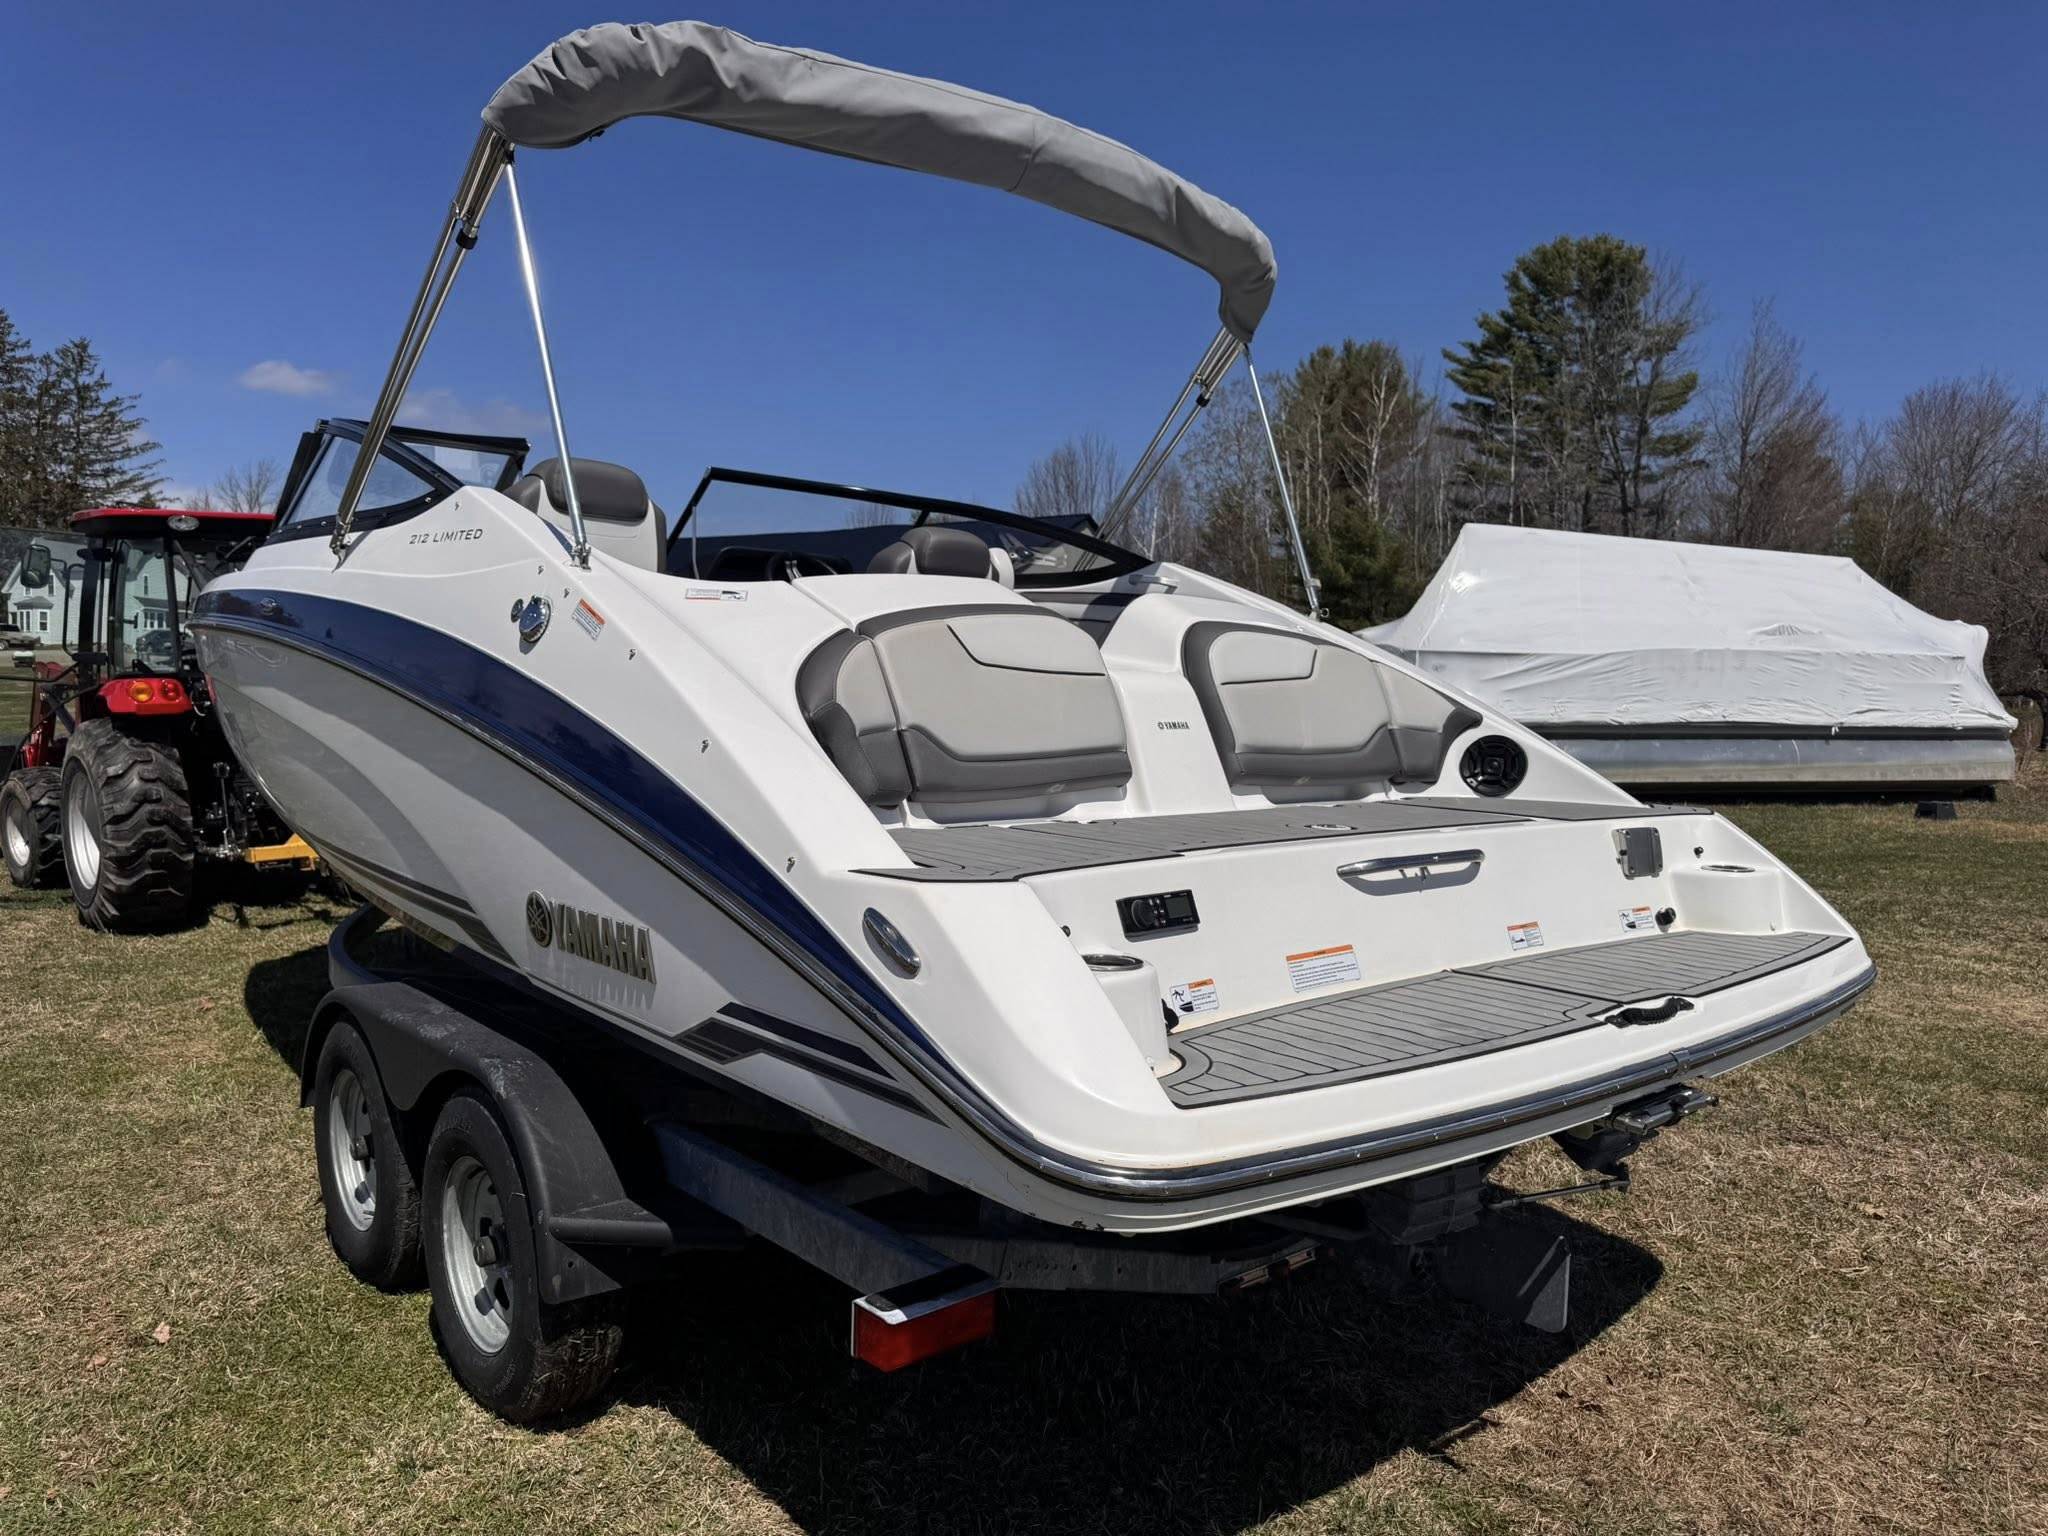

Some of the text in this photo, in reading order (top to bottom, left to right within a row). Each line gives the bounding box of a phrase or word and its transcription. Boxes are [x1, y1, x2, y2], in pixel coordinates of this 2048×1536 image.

[409, 528, 483, 544] 212 LIMITED
[1163, 721, 1190, 730] YAMAHA
[549, 900, 657, 984] YAMAHA
